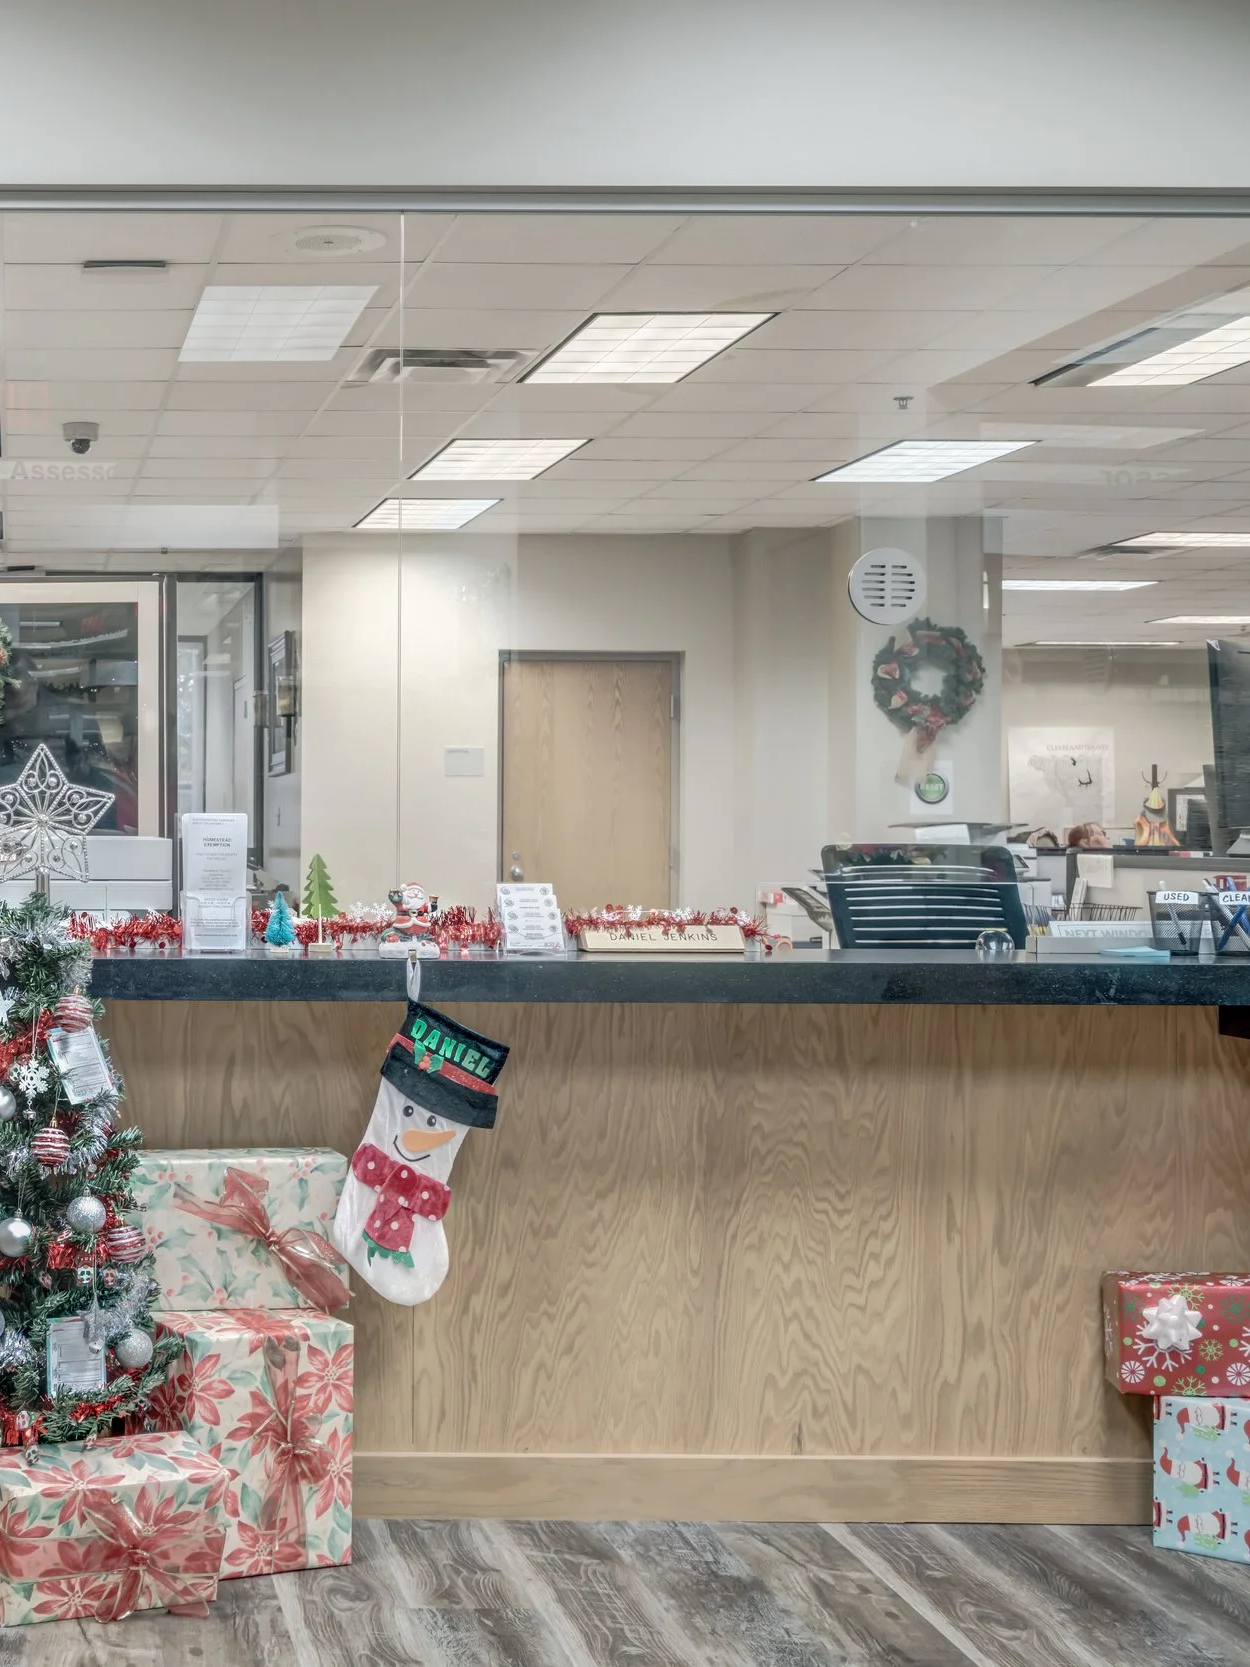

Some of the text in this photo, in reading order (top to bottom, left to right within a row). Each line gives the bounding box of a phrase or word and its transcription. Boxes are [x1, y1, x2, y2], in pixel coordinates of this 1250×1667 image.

[1163, 892, 1190, 901] USED
[1222, 893, 1250, 903] CLEA
[609, 932, 718, 942] DANIEL JENKINS
[1101, 929, 1153, 938] WINDO
[410, 1018, 491, 1078] DANIEL
